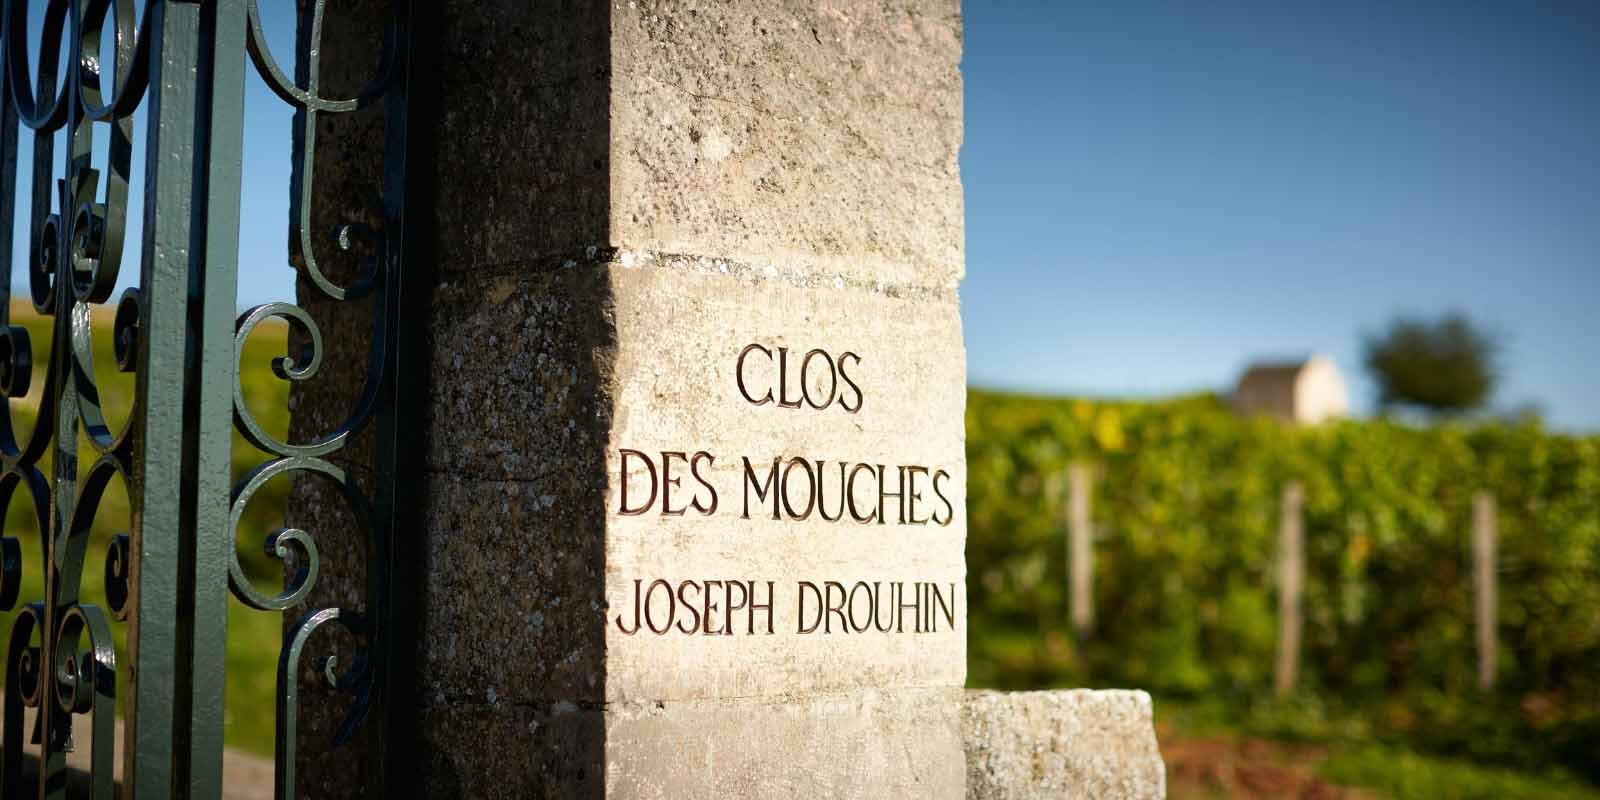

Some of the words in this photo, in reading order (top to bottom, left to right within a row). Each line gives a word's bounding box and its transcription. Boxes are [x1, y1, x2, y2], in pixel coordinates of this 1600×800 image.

[736, 343, 863, 414] CLOS
[618, 448, 718, 517] DES
[741, 455, 954, 526] MOUCHES
[616, 578, 775, 636] JOSEPH
[797, 580, 956, 635] DROUHIN
